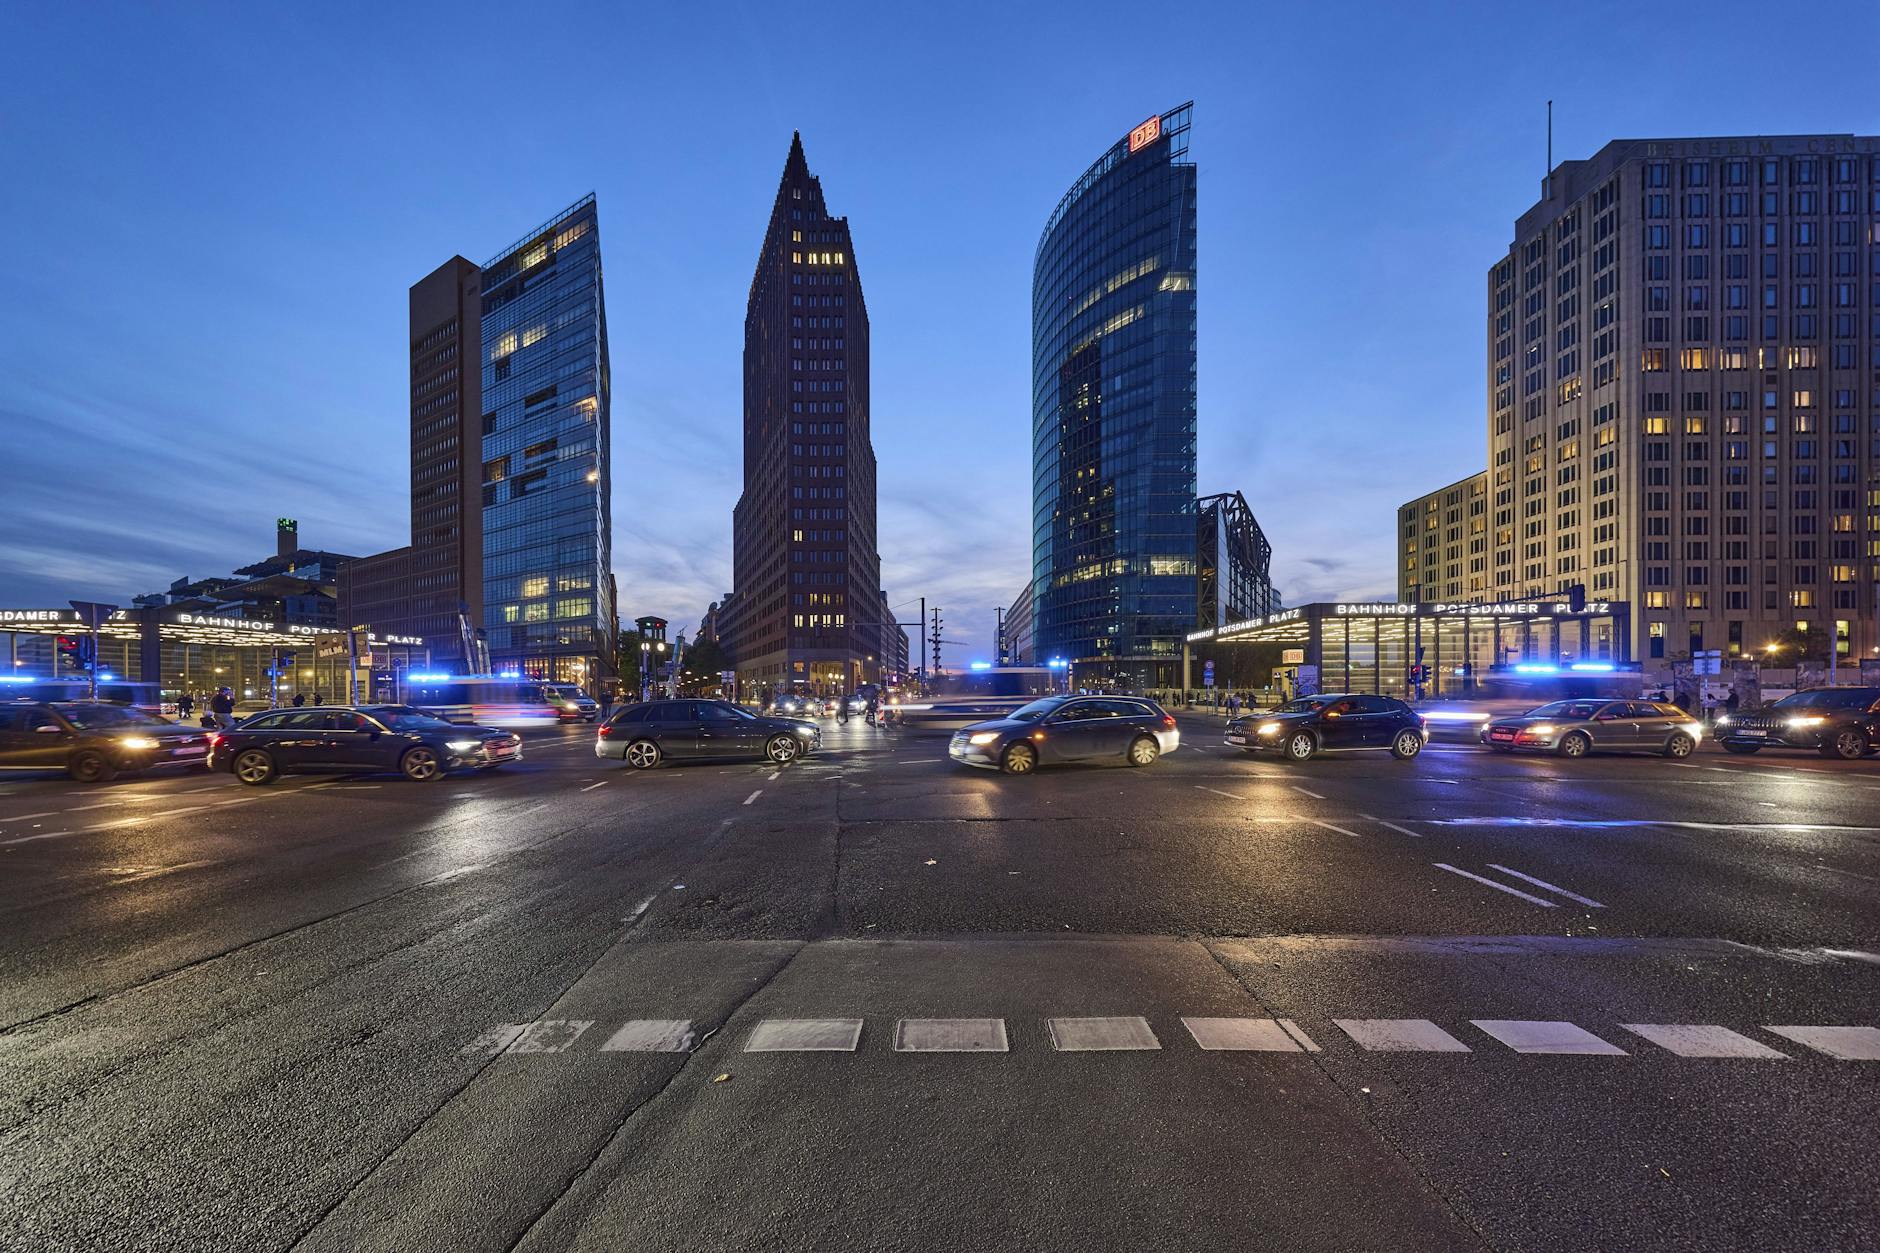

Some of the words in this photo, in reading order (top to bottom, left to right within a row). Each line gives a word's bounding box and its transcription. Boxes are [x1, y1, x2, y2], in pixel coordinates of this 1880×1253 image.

[1133, 121, 1157, 148] DB
[1337, 604, 1417, 614] BAHNHOF
[1436, 604, 1539, 614] POTSDAMER
[1556, 603, 1609, 613] PLTZ
[180, 613, 274, 630] BAHNHOF
[387, 634, 423, 645] PLATZ
[1187, 629, 1214, 641] BAHNHOF
[1218, 618, 1262, 635] POTSDAMER
[1269, 608, 1300, 623] PLATZ
